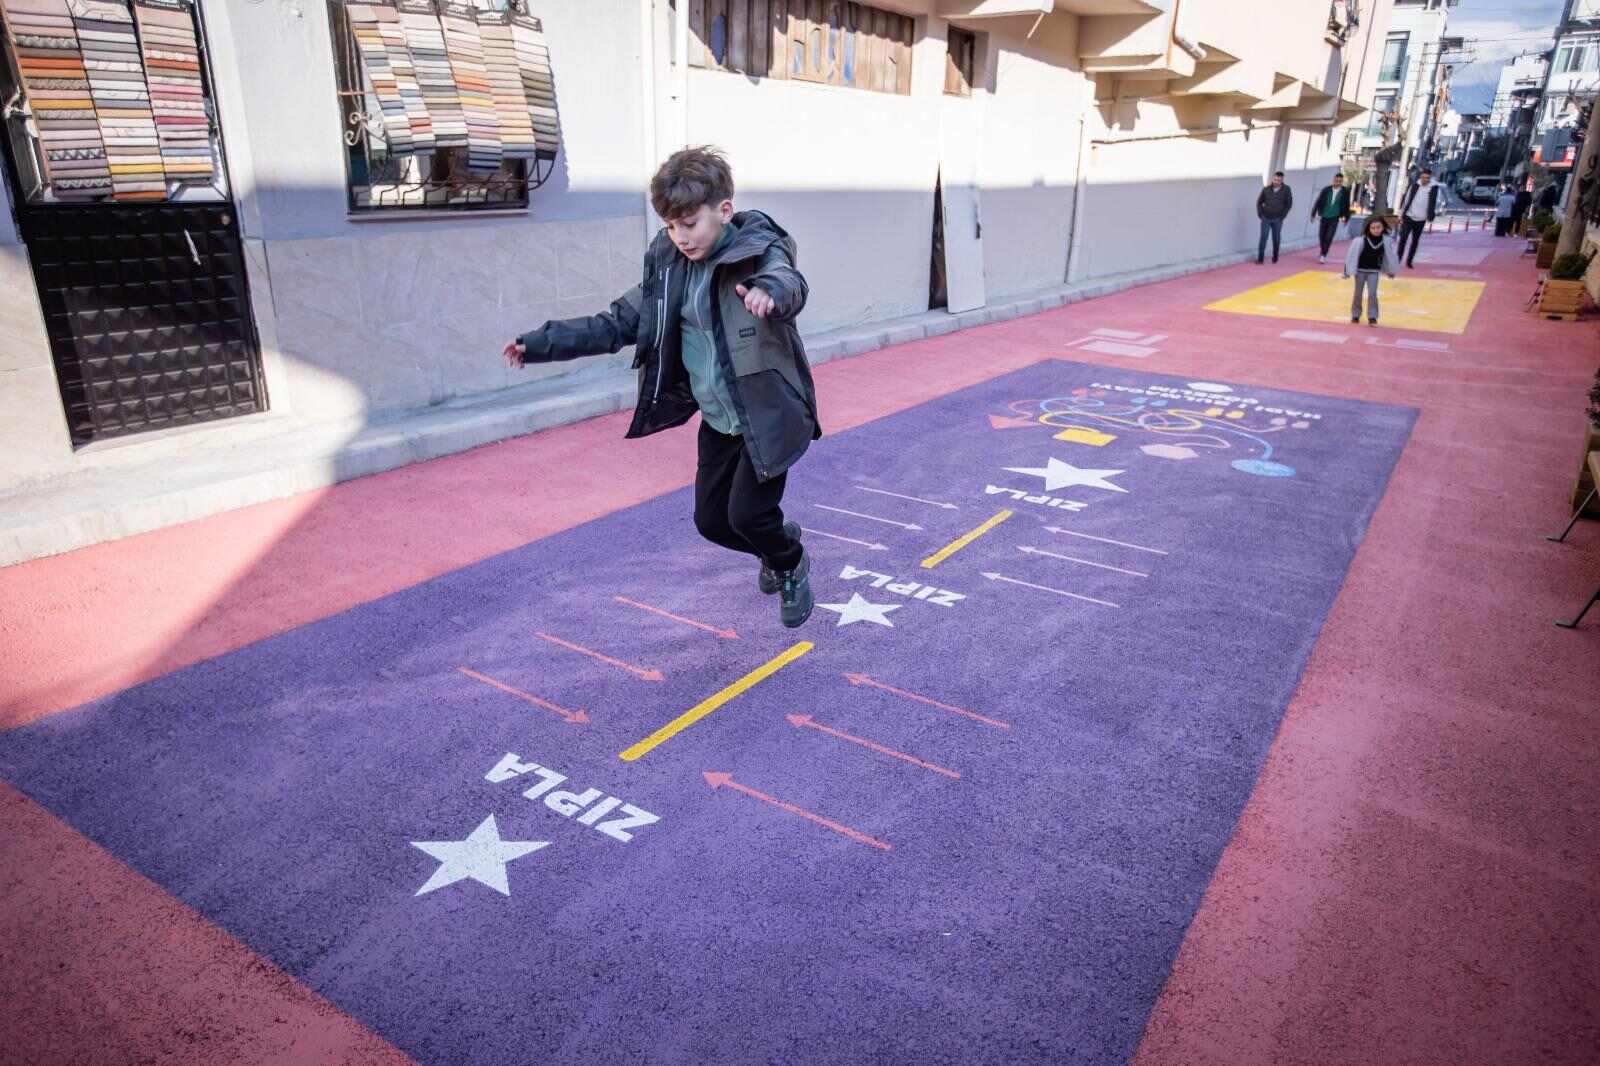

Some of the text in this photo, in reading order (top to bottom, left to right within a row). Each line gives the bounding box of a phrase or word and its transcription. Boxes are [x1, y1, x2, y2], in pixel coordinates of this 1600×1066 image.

[984, 484, 1089, 512] ZIPLA
[838, 564, 967, 608] ZIPLA
[484, 752, 662, 843] ZIPLA
